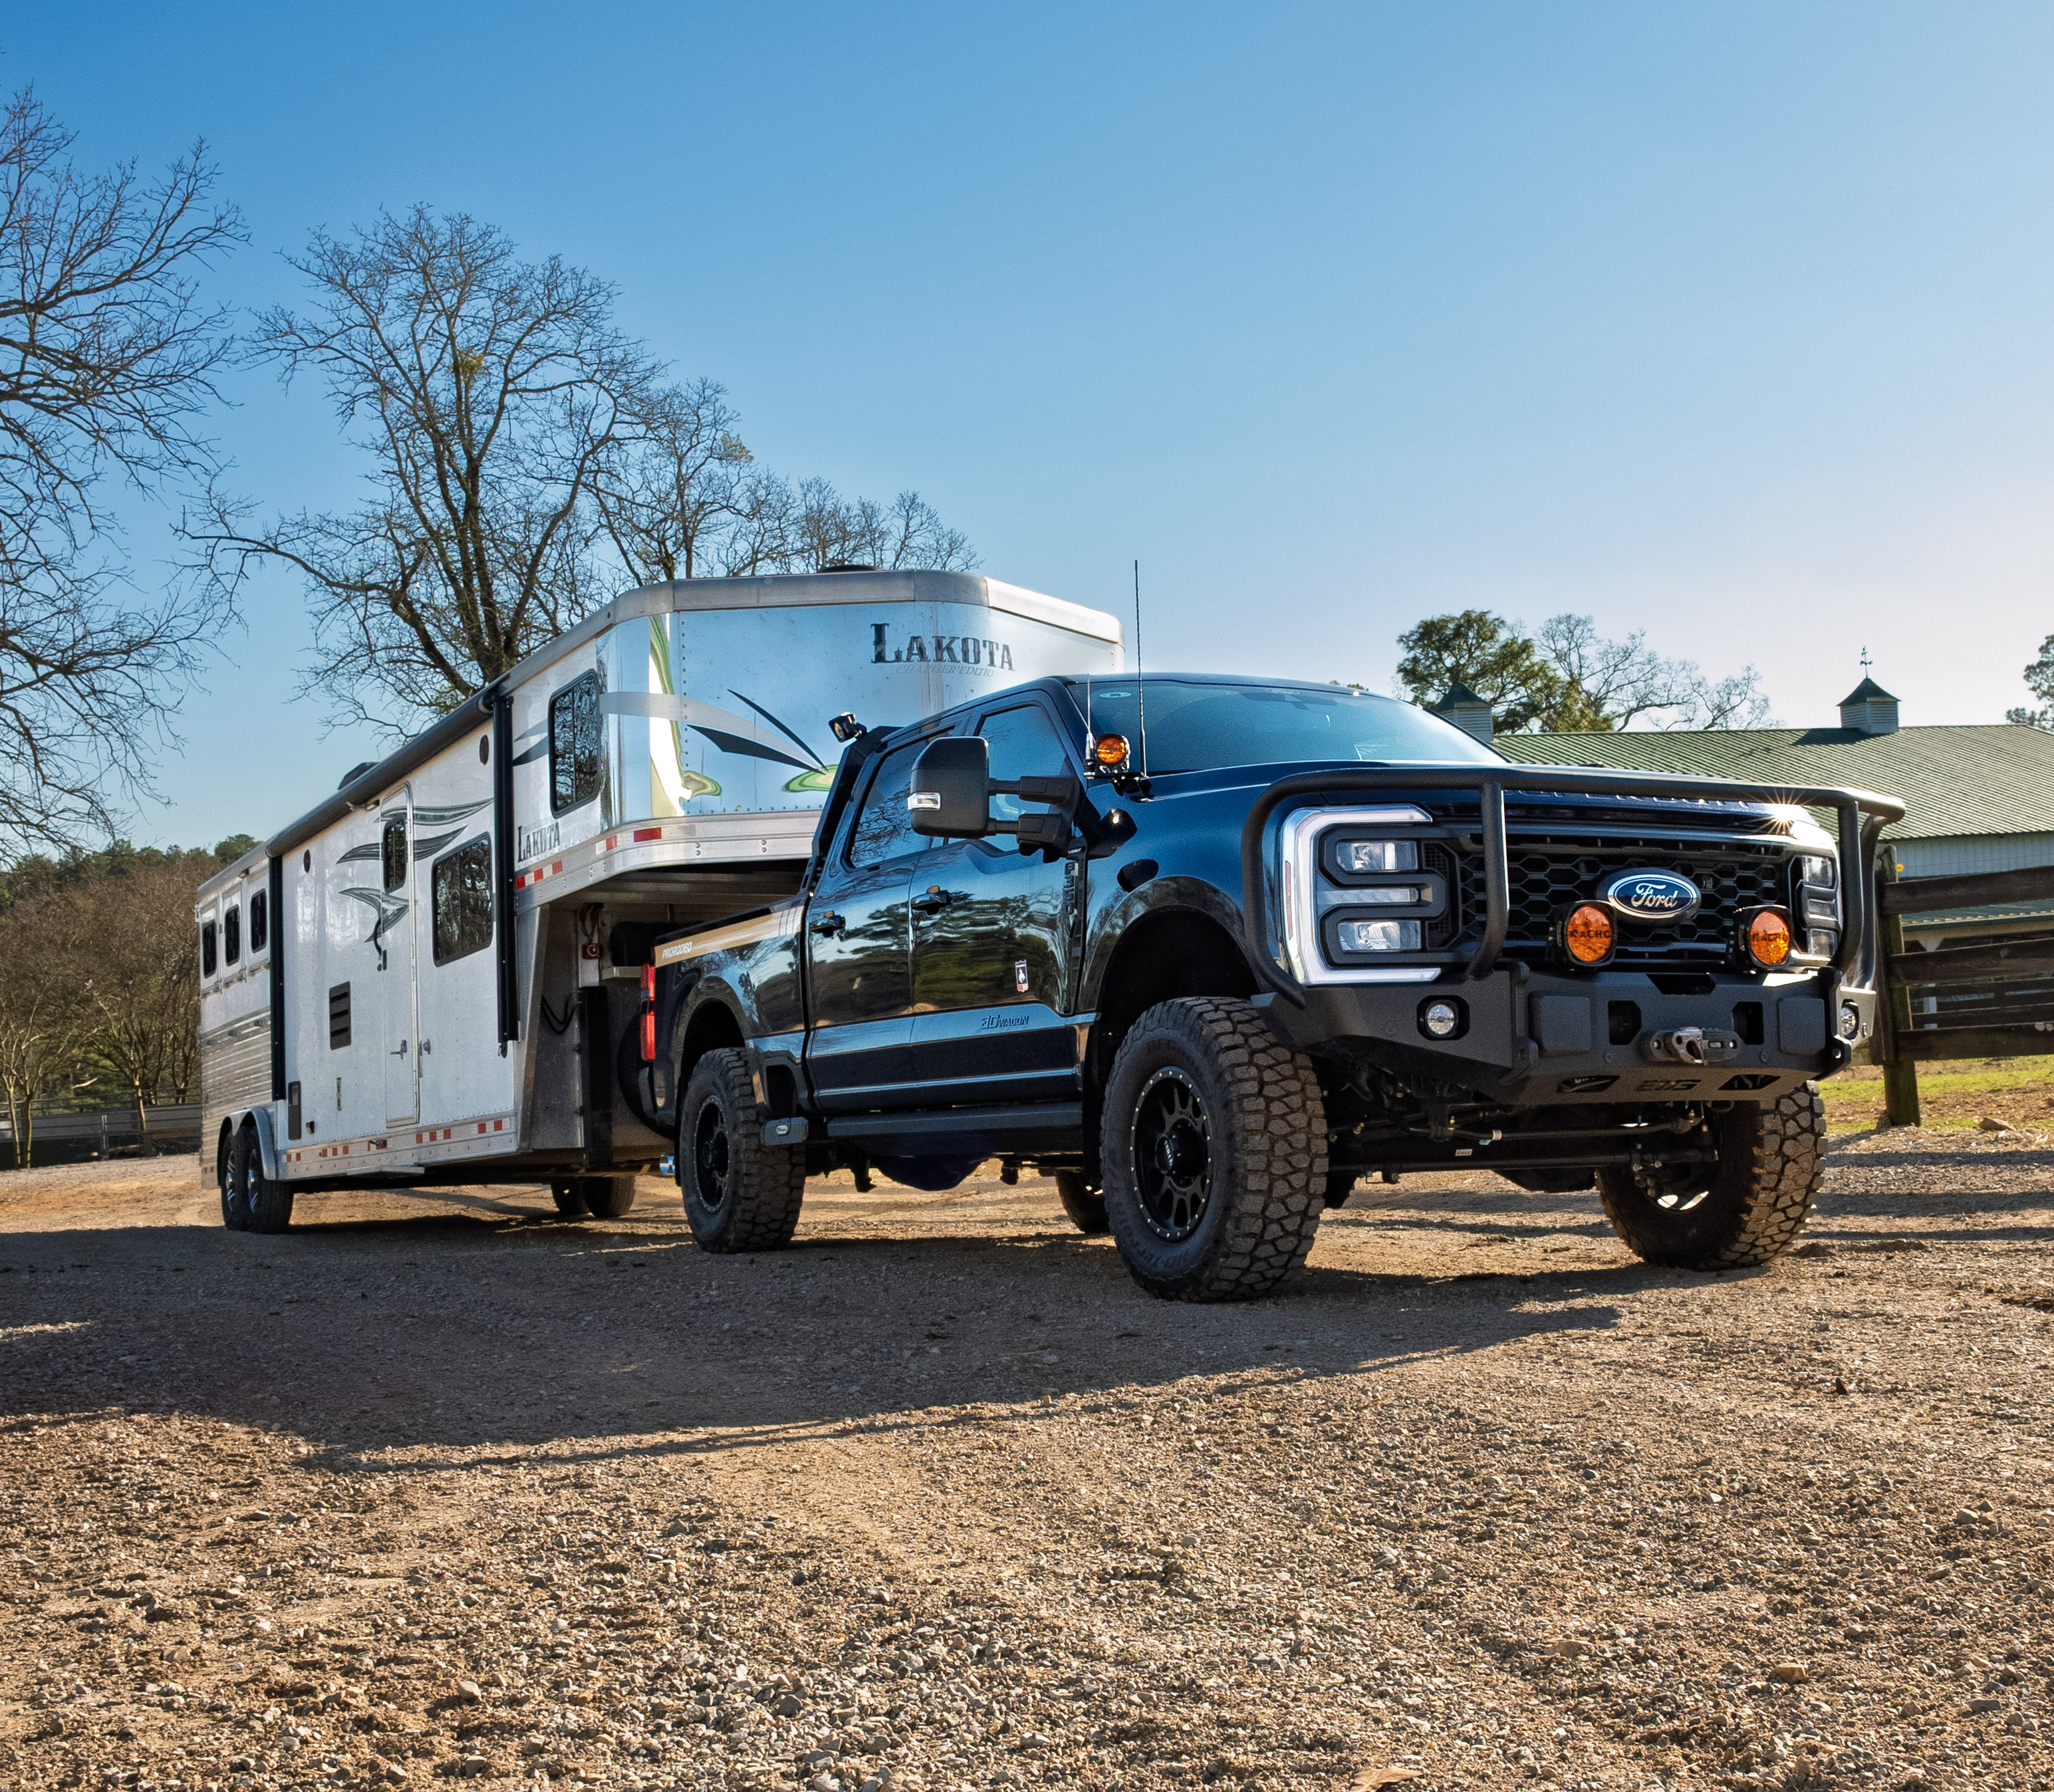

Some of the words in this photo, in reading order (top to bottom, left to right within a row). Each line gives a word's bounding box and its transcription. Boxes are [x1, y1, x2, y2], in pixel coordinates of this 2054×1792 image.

[870, 623, 1015, 672] LAKOTA
[517, 821, 561, 862] LAKOTA
[1632, 883, 1678, 908] Ford
[662, 942, 693, 960] PRORODEO
